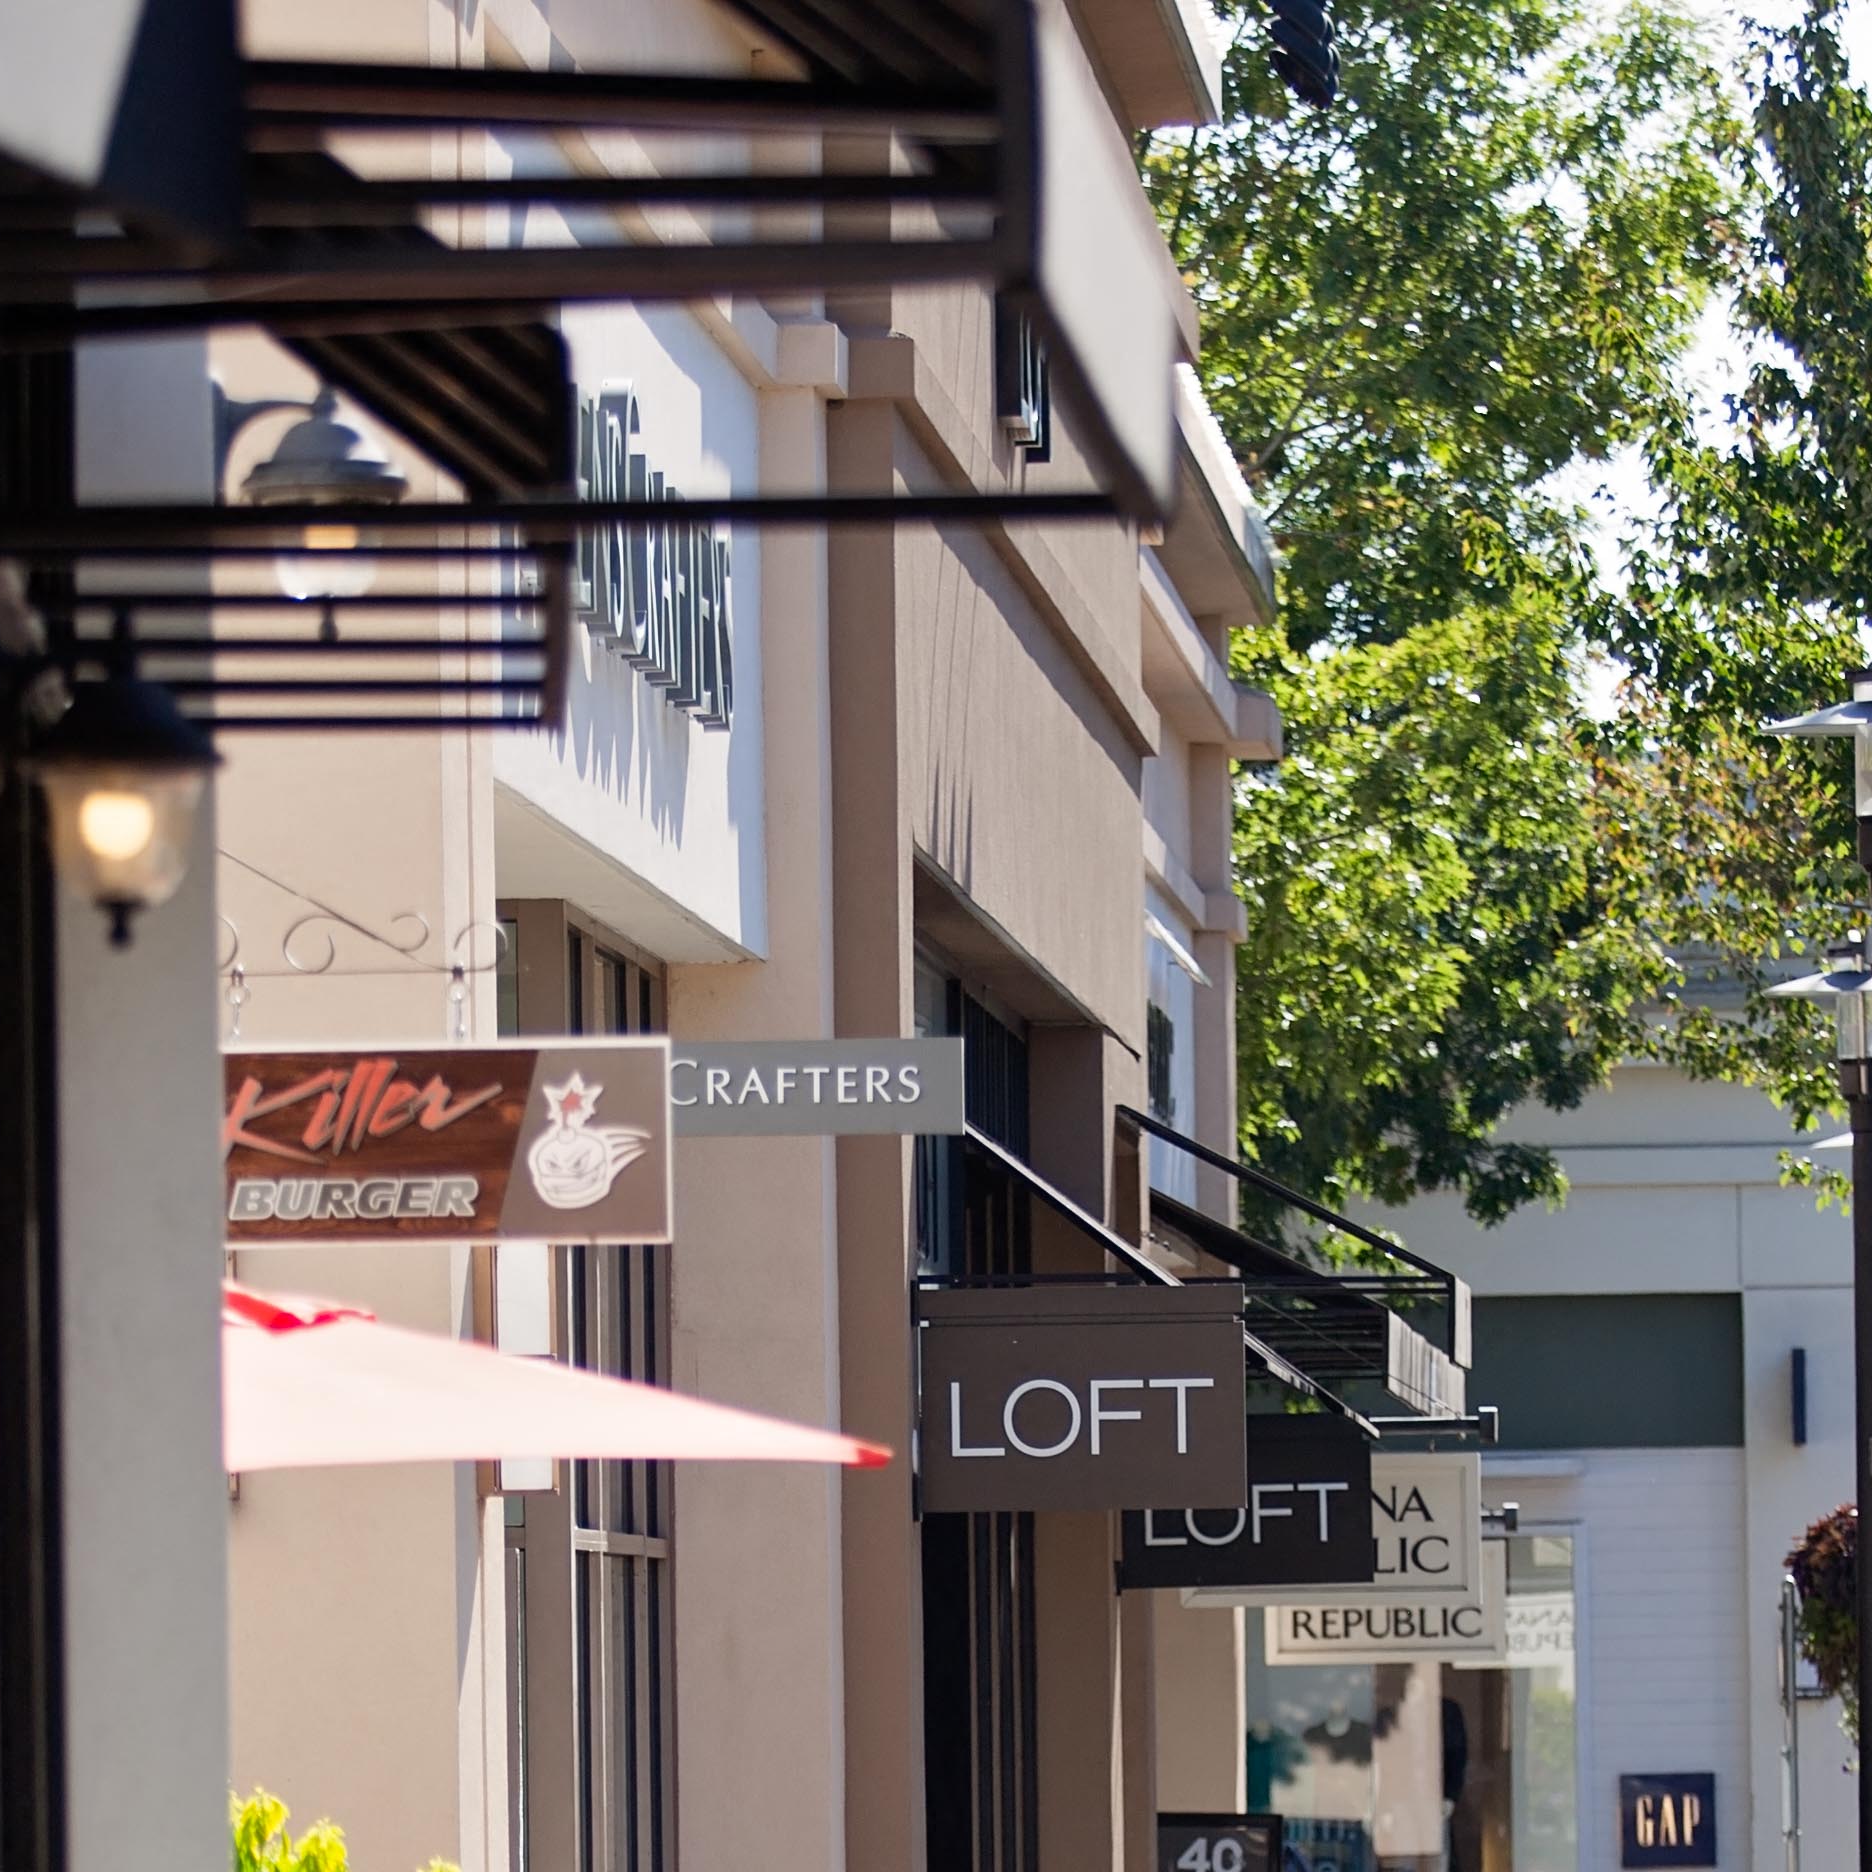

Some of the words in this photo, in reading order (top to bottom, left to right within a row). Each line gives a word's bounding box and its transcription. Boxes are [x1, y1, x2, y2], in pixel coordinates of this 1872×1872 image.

[574, 378, 734, 733] ENSCRAFTERS
[222, 1058, 503, 1165] Killer
[670, 1059, 921, 1106] CRAFTERS
[229, 1175, 479, 1221] BURGER
[950, 1377, 1215, 1458] LOFT
[1144, 1482, 1349, 1547] LOFT
[1291, 1606, 1483, 1640] REPUBLIC
[1635, 1792, 1701, 1848] GAP
